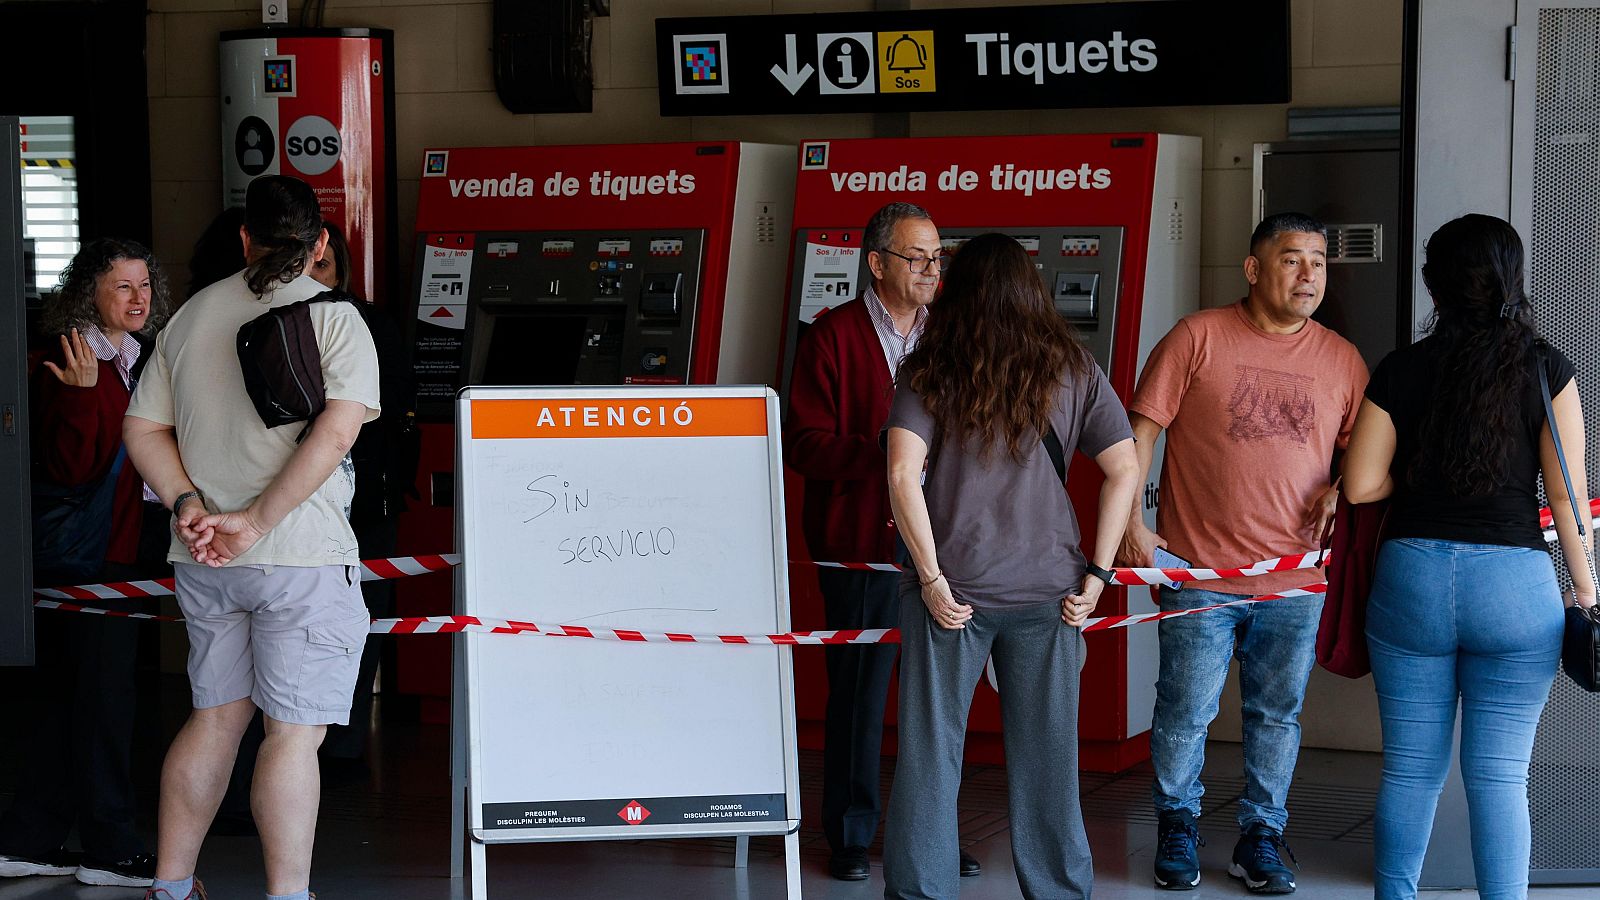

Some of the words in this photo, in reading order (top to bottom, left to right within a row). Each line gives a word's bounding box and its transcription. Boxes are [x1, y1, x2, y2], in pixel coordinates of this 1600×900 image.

[965, 31, 1158, 85] Tiquets
[895, 76, 920, 89] Sos
[287, 136, 339, 156] SOS
[449, 172, 534, 198] venda
[544, 171, 580, 197] de
[589, 169, 696, 201] tiquets
[830, 165, 927, 192] venda
[937, 164, 979, 191] de
[989, 163, 1112, 196] tiquets
[536, 401, 693, 427] ATENCIÓ
[557, 526, 676, 565] SERVICIO
[497, 818, 533, 826] DISCULPIN
[548, 816, 586, 824] MOLÈSTIES
[525, 810, 558, 818] PREGUEM
[627, 806, 642, 821] M
[683, 811, 720, 819] DISCULPEN
[733, 810, 770, 818] MOLESTIAS
